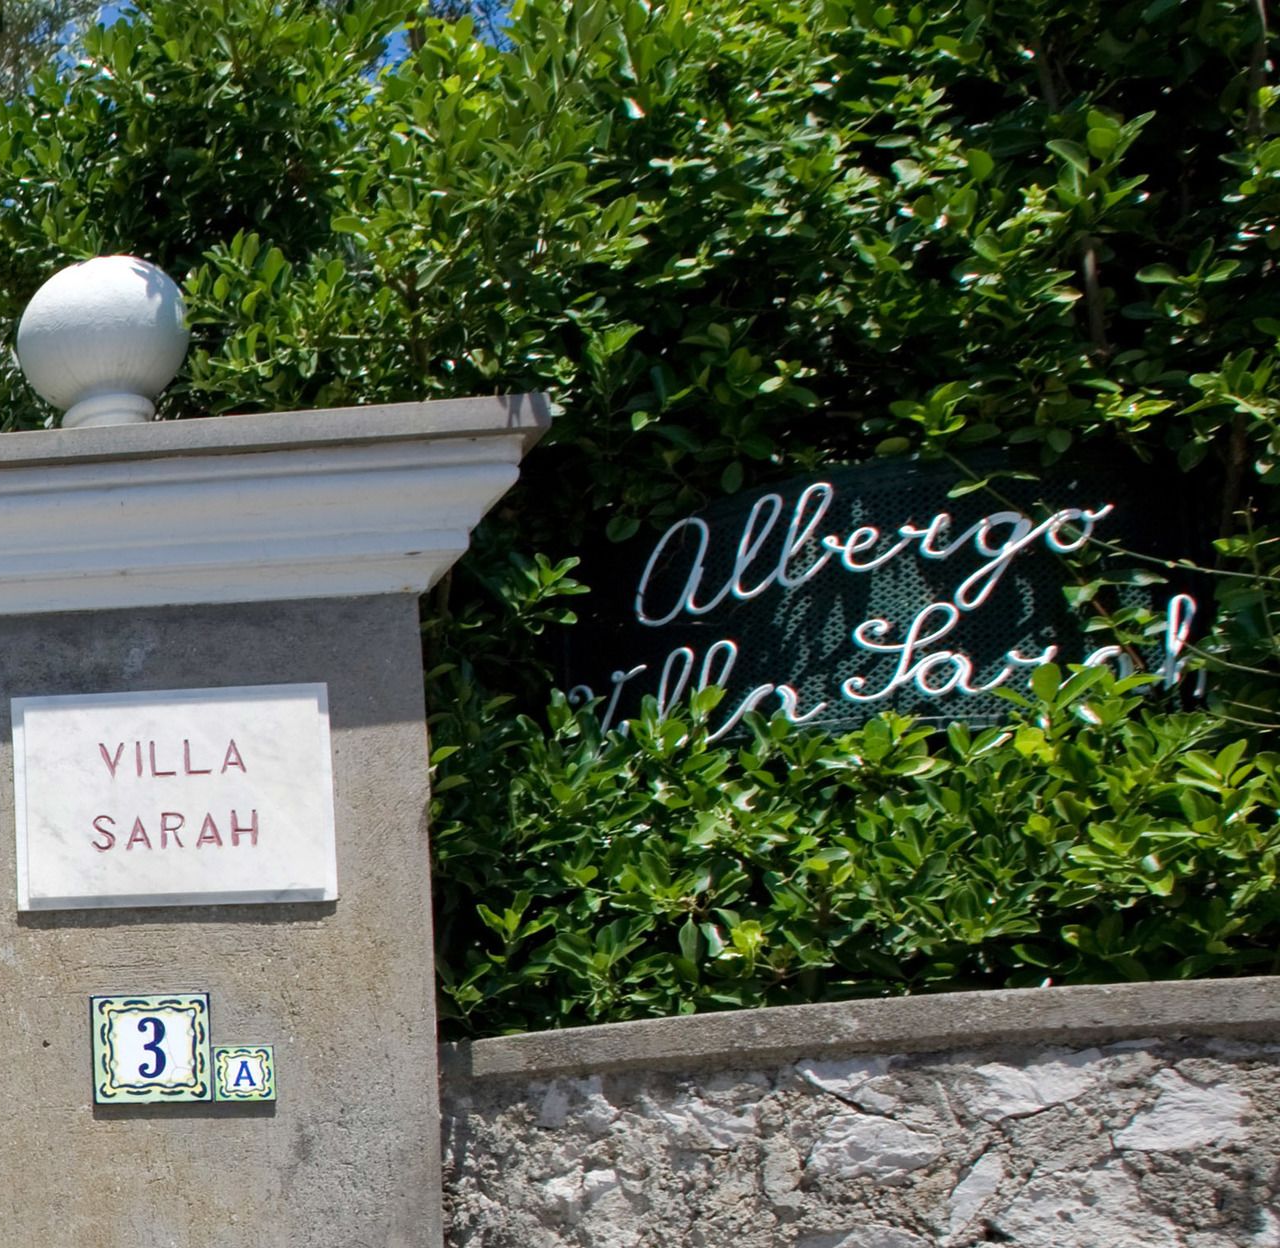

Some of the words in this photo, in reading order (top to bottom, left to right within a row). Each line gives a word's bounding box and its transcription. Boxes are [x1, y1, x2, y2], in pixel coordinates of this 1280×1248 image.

[635, 481, 1115, 627] Albergo
[98, 738, 248, 779] VILLA
[91, 808, 260, 853] SARAH
[137, 1016, 168, 1080] 3
[232, 1060, 257, 1088] A
